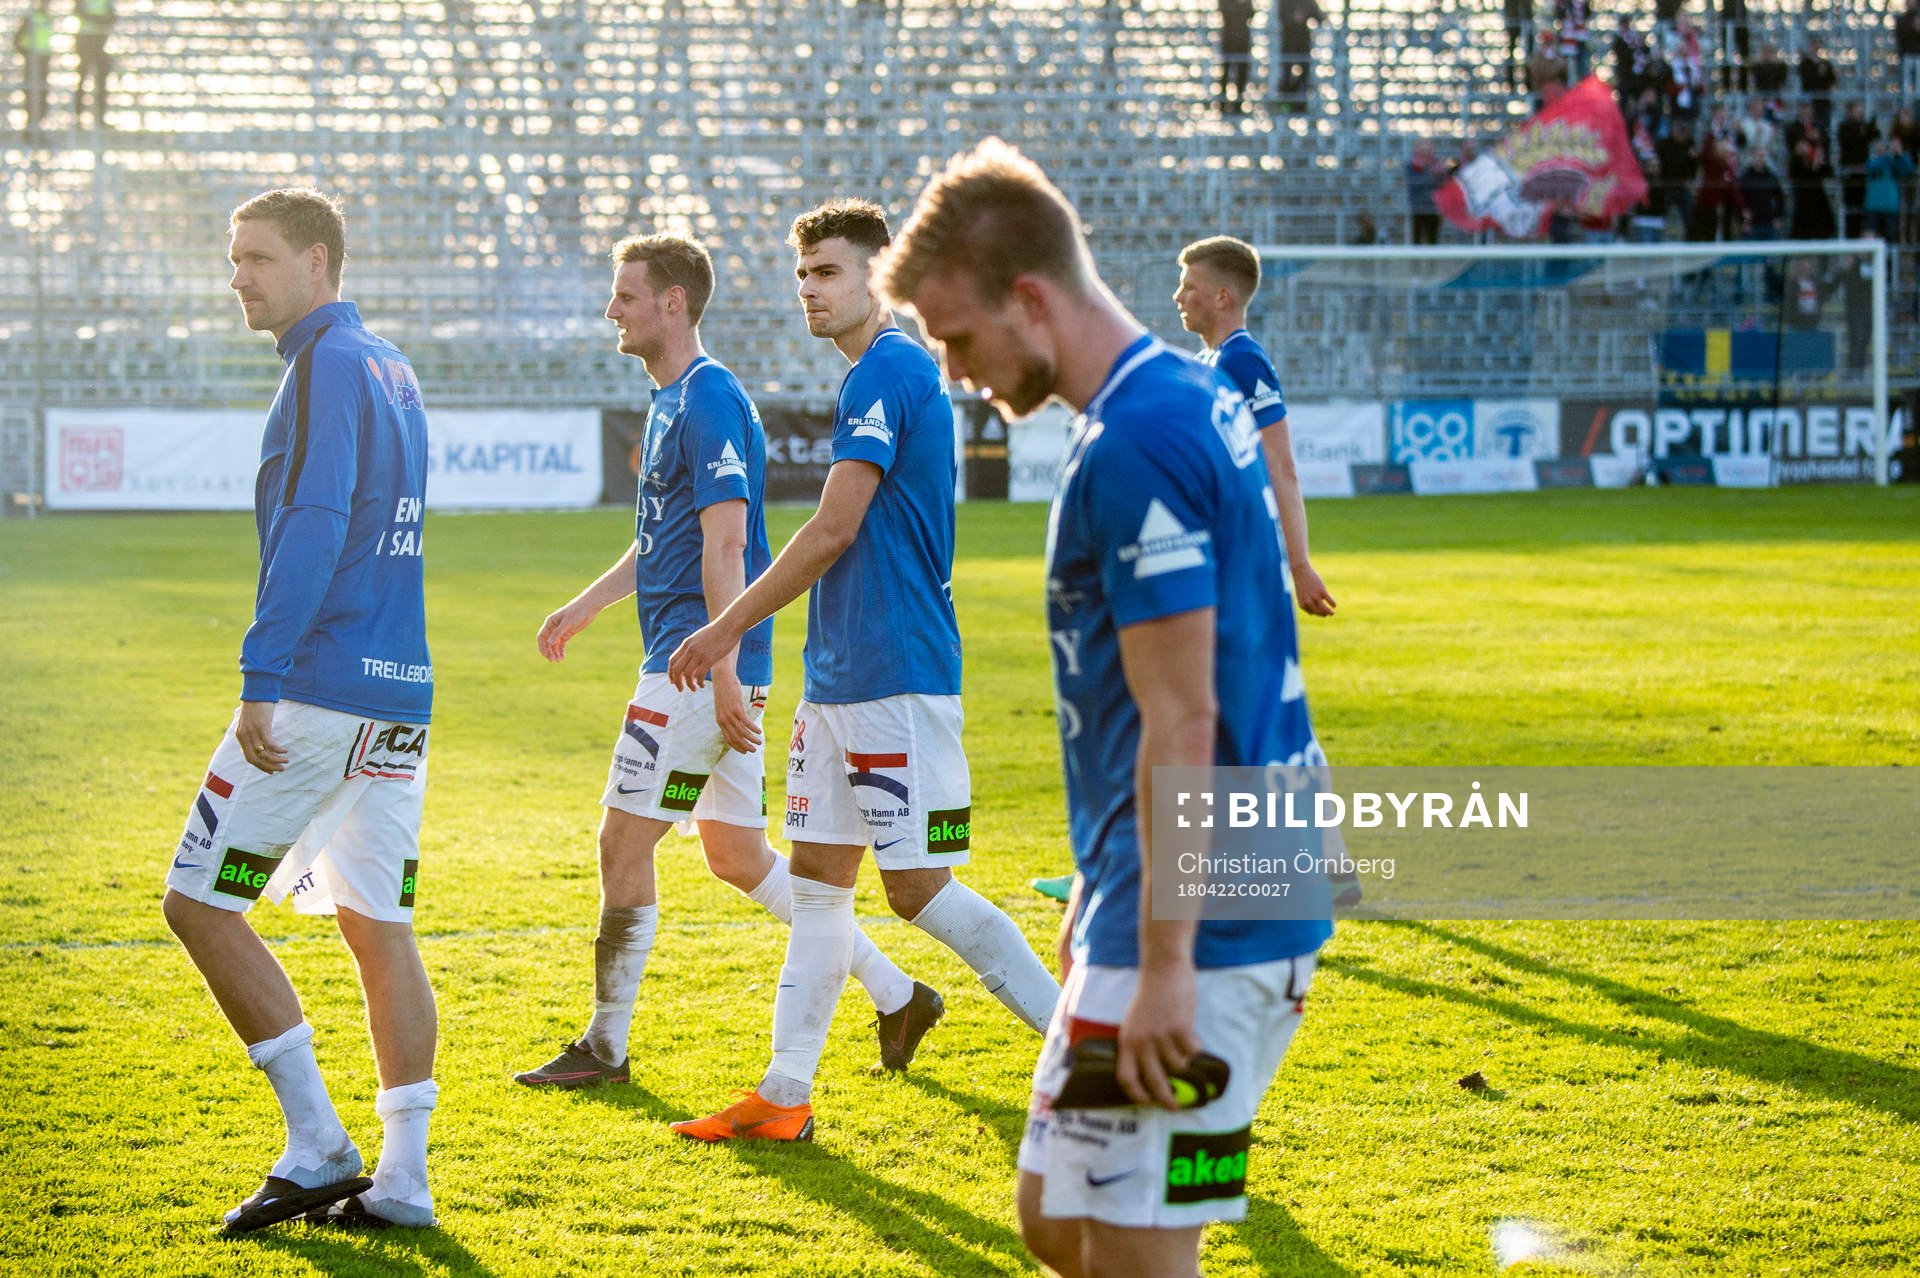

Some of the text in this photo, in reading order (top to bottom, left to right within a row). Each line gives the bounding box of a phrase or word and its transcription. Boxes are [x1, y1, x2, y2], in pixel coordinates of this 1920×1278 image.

[444, 440, 585, 473] KAPITAL
[362, 658, 433, 683] TRELLEBOR
[871, 808, 895, 817] Hamn
[897, 807, 910, 817] AB
